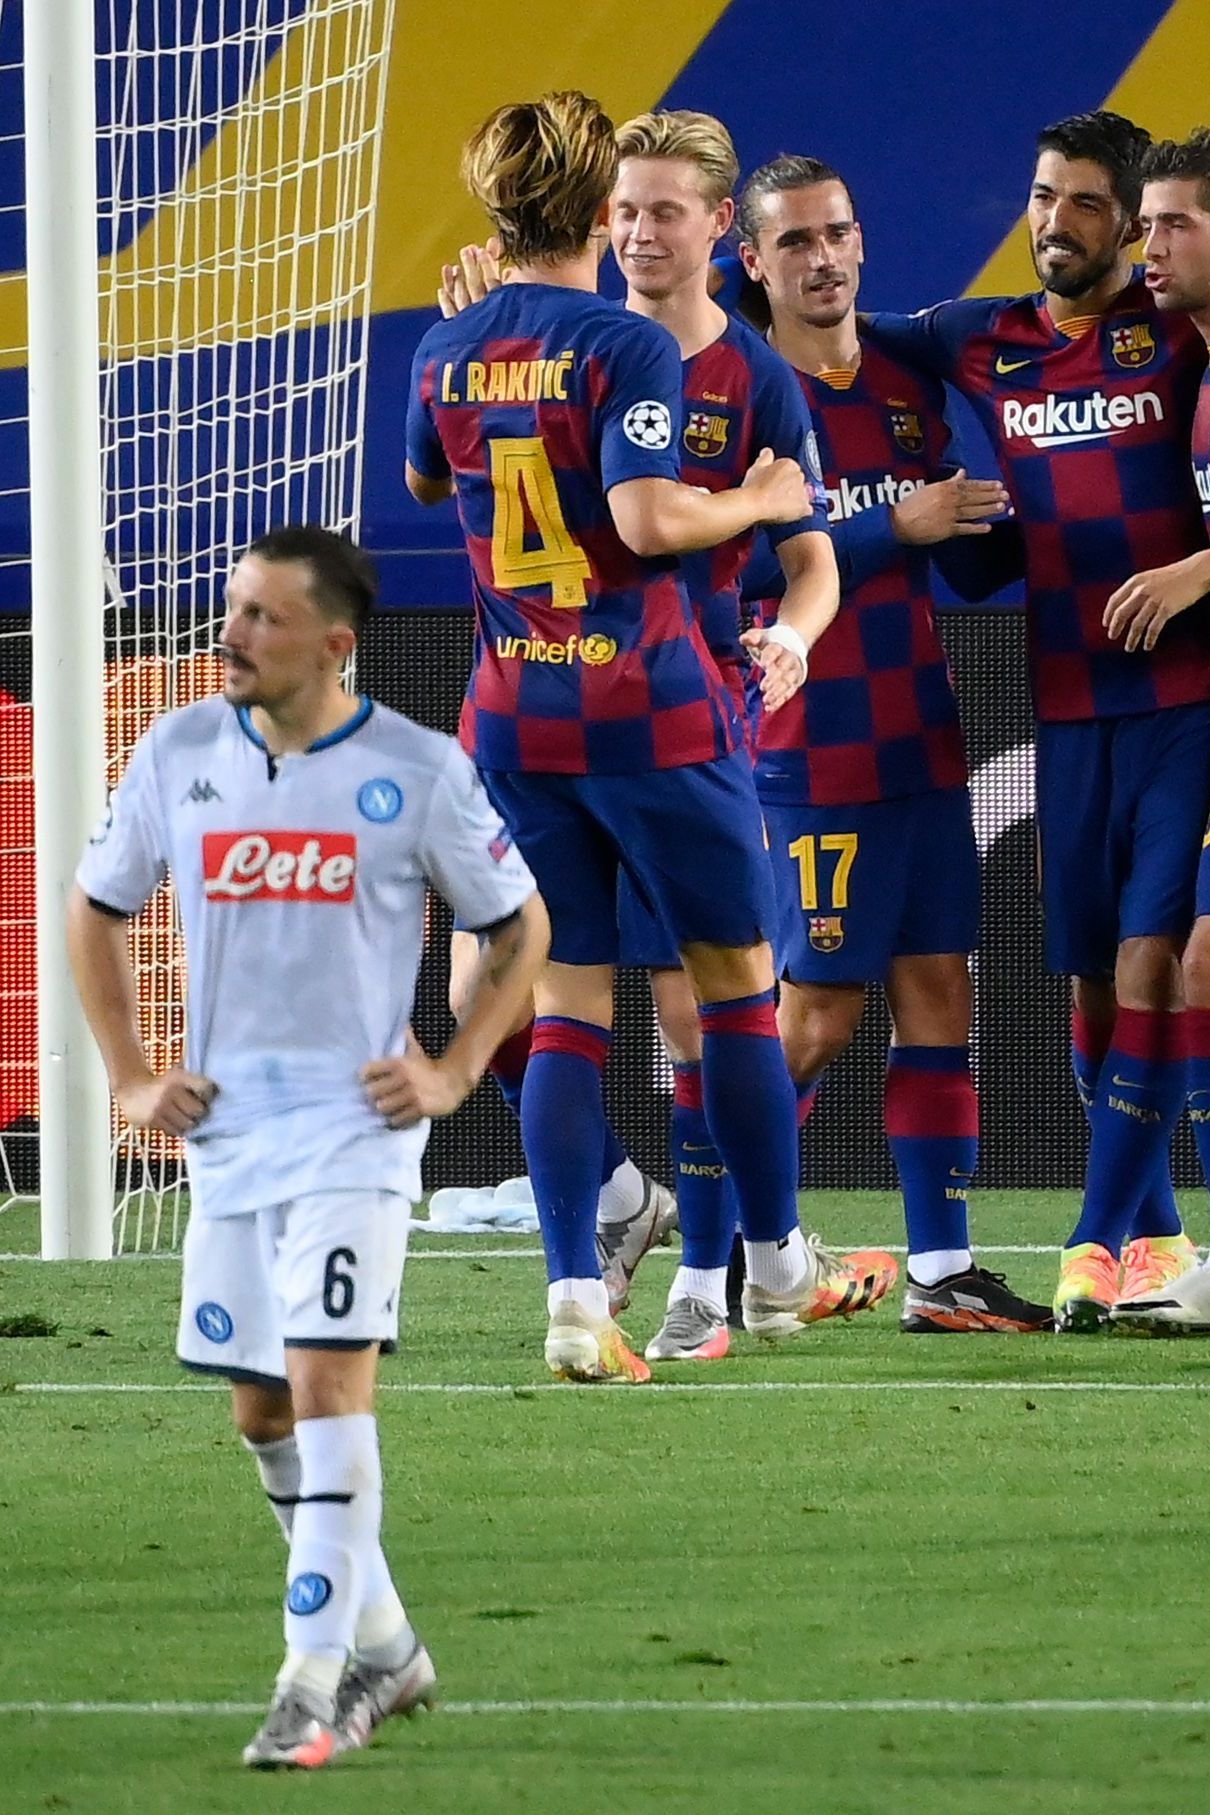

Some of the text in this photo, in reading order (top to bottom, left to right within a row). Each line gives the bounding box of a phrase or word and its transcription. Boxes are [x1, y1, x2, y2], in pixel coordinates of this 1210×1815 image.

[1003, 391, 1164, 439] Rakuten
[489, 437, 593, 609] 4
[824, 474, 926, 521] akute
[496, 631, 577, 666] unicef
[204, 834, 355, 897] Lete
[788, 832, 858, 910] 17
[322, 1246, 357, 1319] 6
